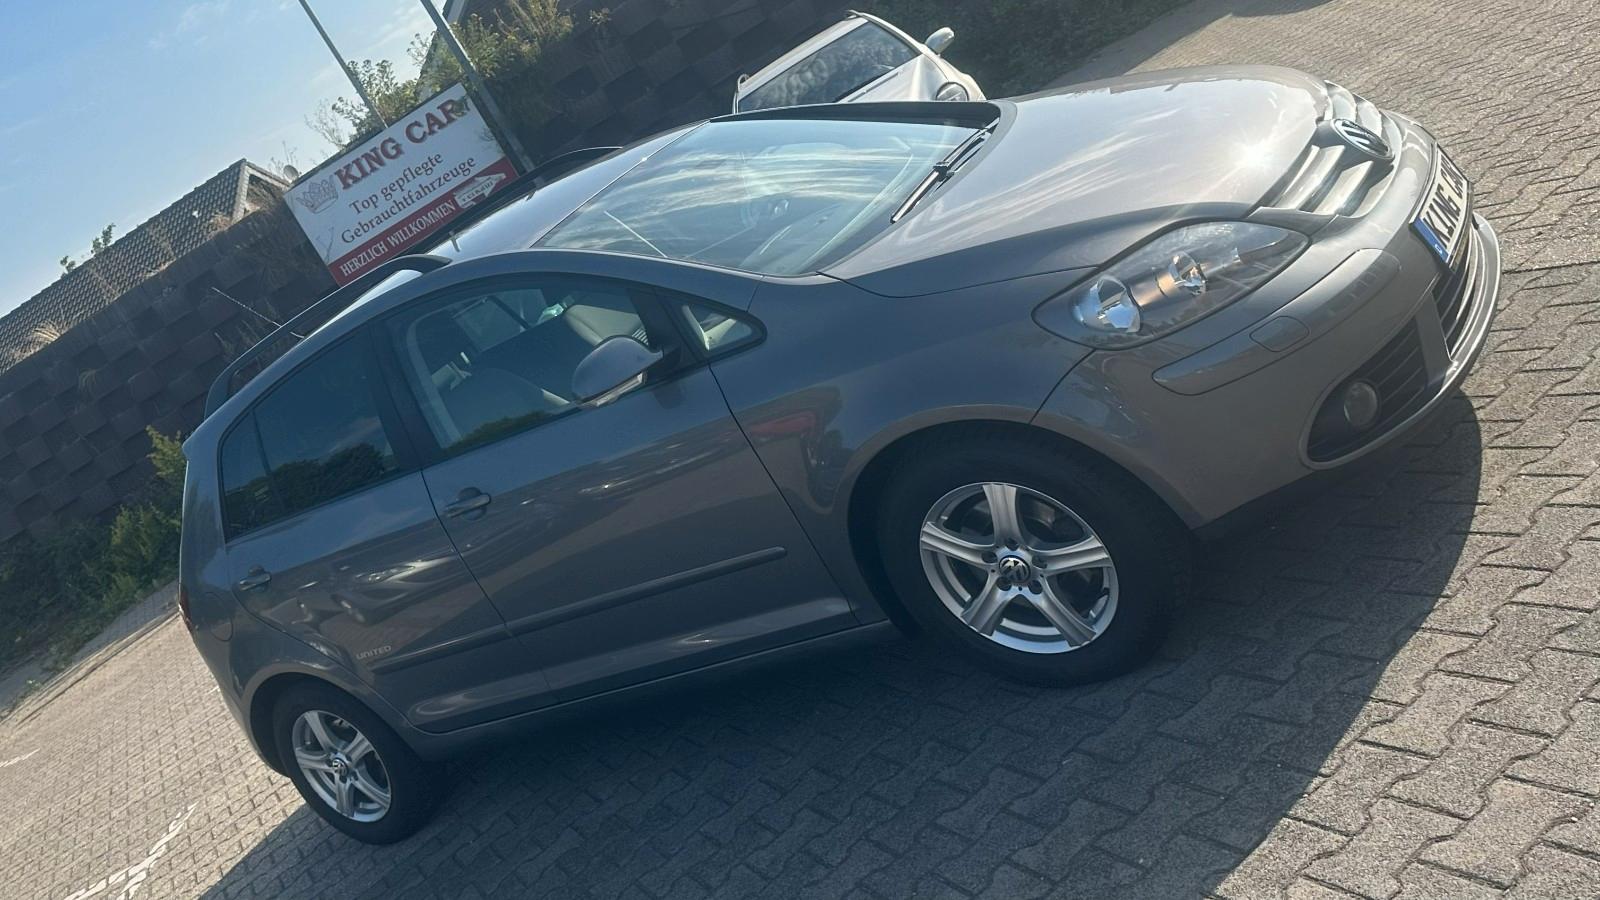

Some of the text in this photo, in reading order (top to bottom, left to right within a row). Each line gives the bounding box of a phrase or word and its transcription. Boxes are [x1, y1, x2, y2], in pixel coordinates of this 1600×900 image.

[334, 99, 465, 190] KING CAR
[341, 155, 477, 244] Gebrauchtfahrzeuge
[348, 188, 380, 215] Top
[381, 152, 444, 200] gepflegte
[1422, 183, 1462, 249] KING
[339, 201, 457, 277] HERZLICH WILLKOMMEN
[356, 645, 392, 660] UNITED
